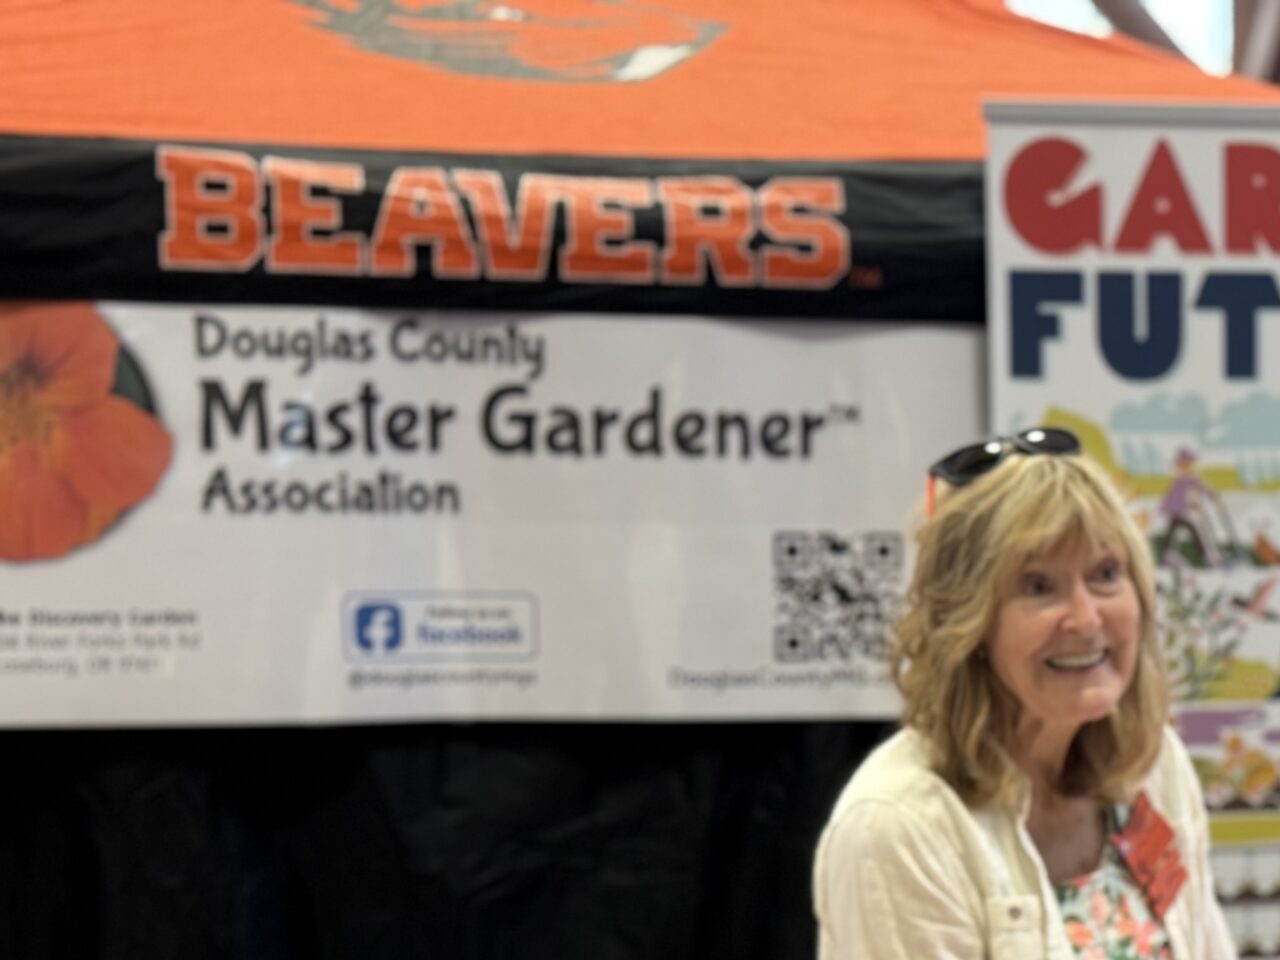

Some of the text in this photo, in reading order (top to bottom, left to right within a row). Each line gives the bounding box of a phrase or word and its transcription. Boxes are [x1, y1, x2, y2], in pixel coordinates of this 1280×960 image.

[156, 144, 852, 290] BEAVERS
[194, 316, 546, 377] Douglas County
[200, 379, 454, 456] Master
[482, 386, 825, 461] Gardener
[201, 469, 460, 515] Association
